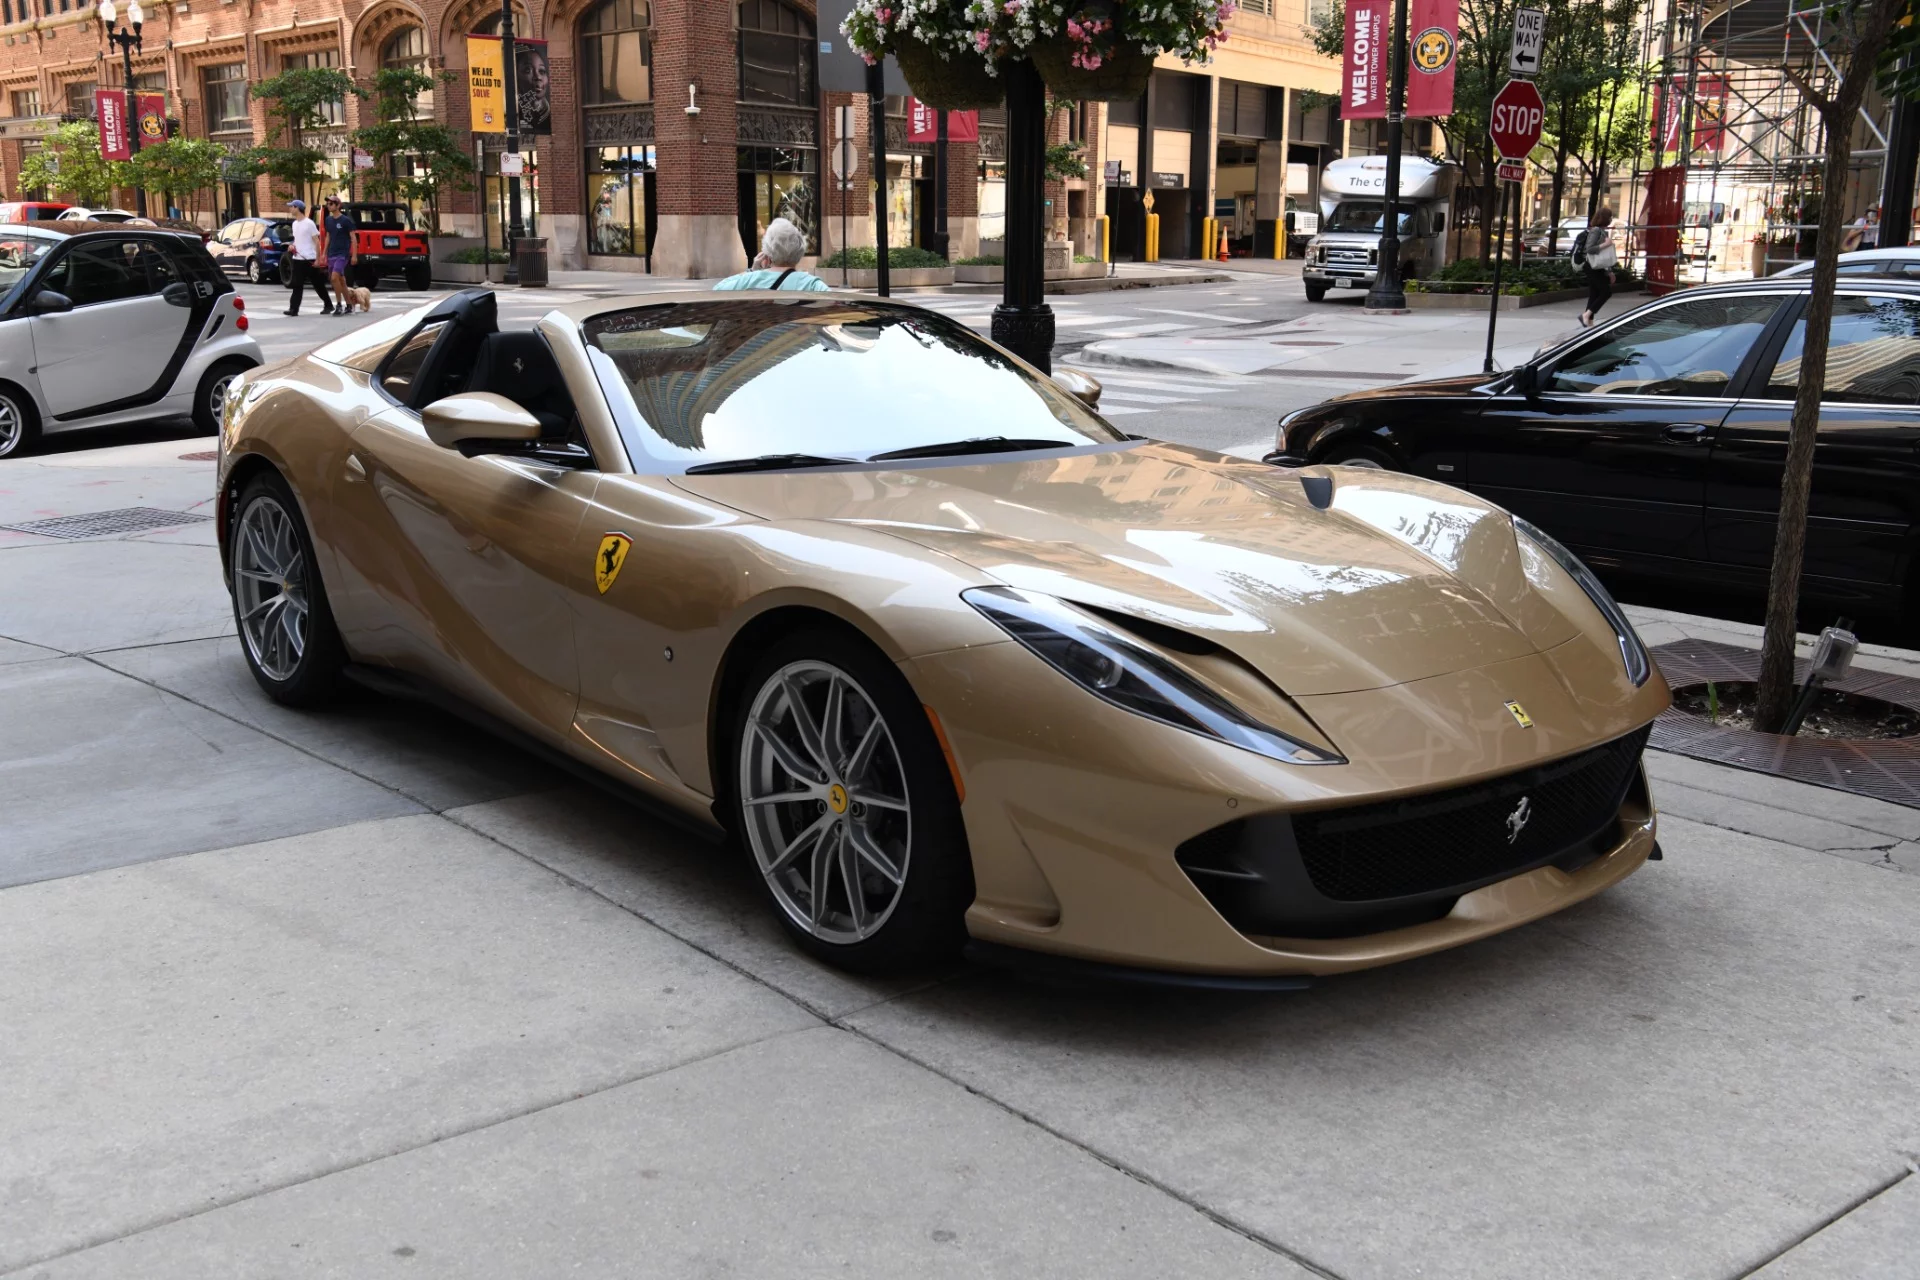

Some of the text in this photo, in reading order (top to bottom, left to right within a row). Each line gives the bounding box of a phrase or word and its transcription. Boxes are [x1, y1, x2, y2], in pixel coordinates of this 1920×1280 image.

[1372, 14, 1380, 46] CAMPUS
[1518, 14, 1540, 31] ONE
[1516, 31, 1539, 48] WAY
[1351, 9, 1371, 107] WELCOME
[1371, 47, 1379, 74] TOWER
[472, 67, 493, 76] WE ARE
[472, 78, 501, 88] CALLED TO
[473, 89, 490, 98] SOLVE
[103, 98, 117, 152] WELCOME
[1494, 104, 1541, 136] STOP
[1501, 168, 1524, 178] ALL WAY
[1350, 177, 1370, 187] The
